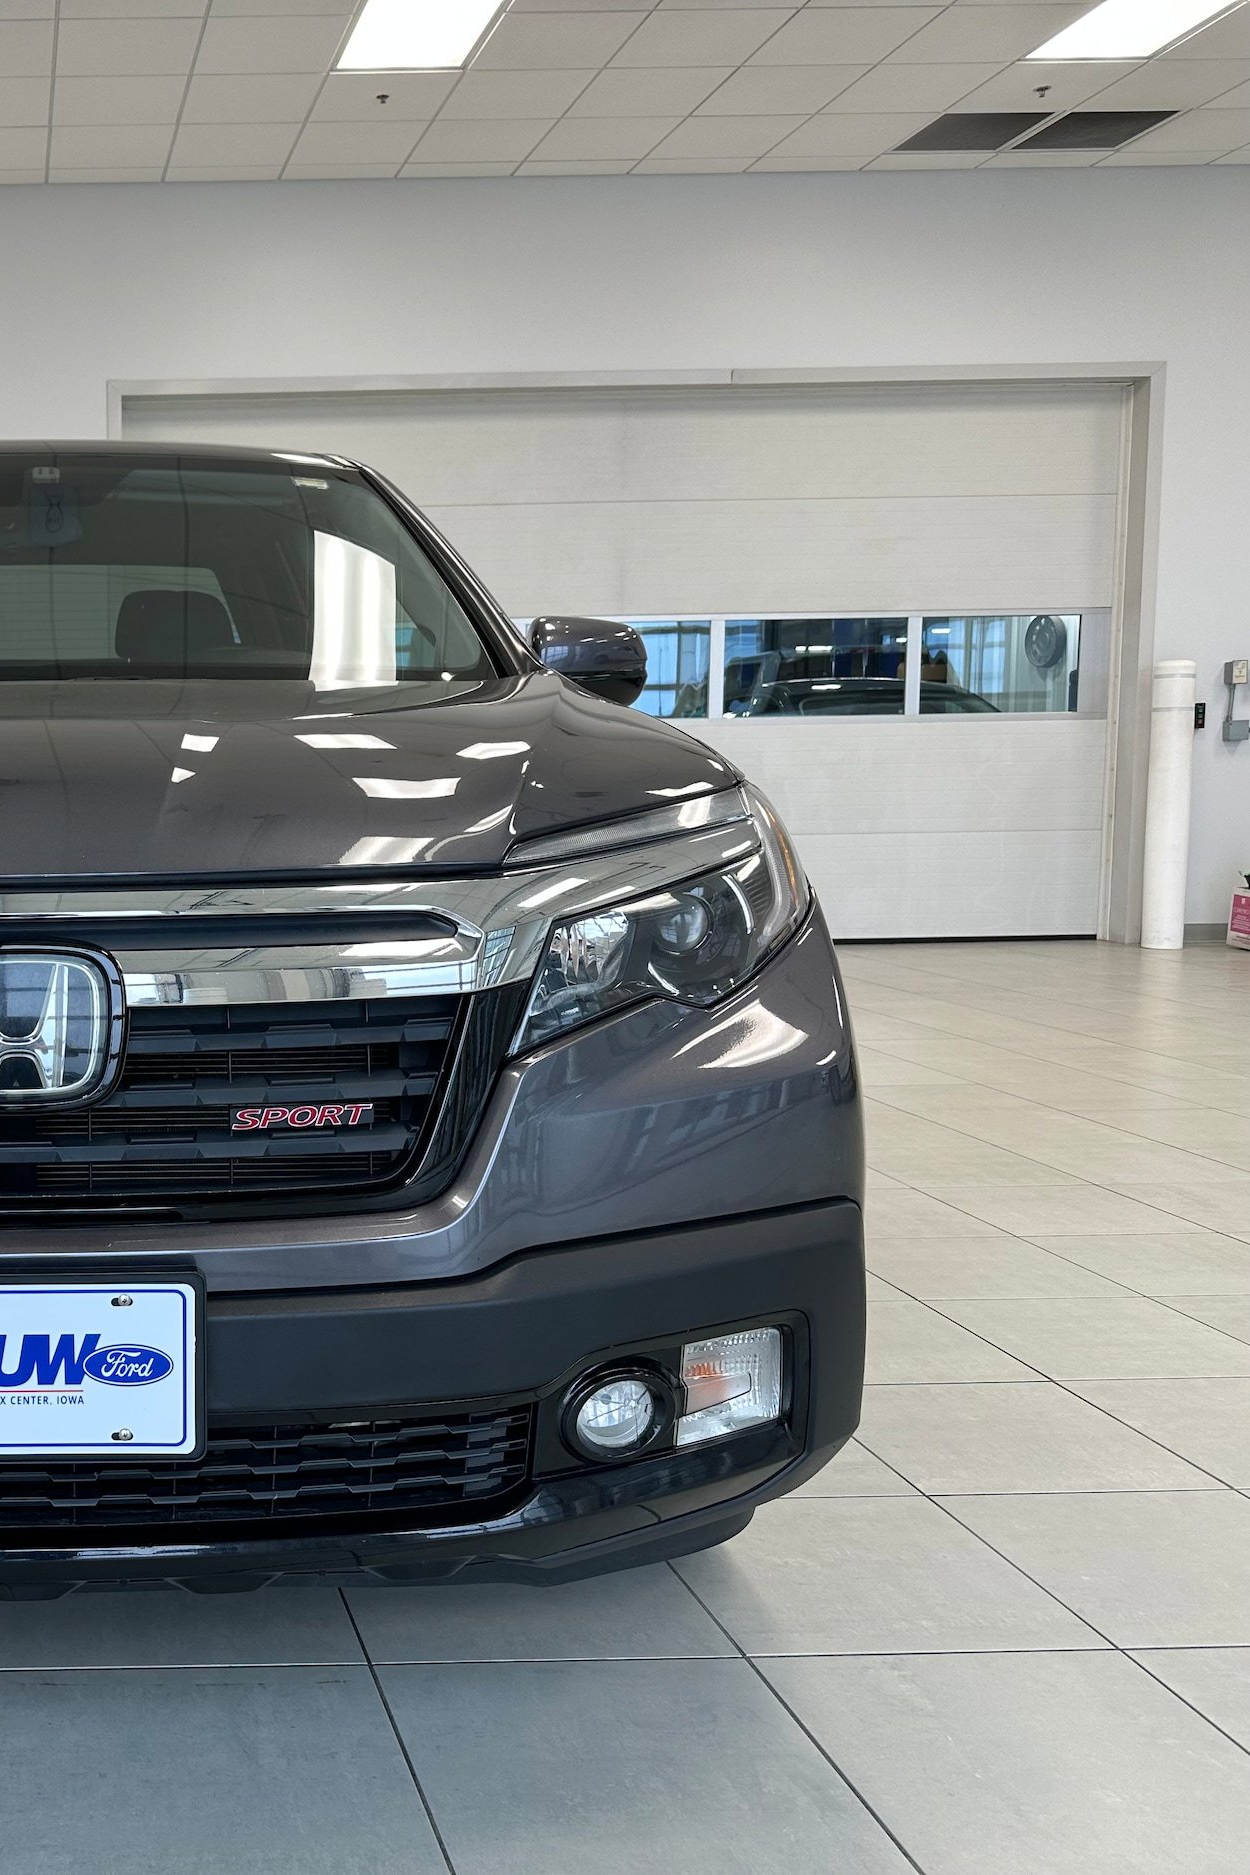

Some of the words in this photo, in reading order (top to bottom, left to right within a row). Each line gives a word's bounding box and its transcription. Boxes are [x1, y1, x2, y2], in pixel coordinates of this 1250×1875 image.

[232, 1103, 373, 1130] SPORT
[100, 1351, 153, 1378] Ford
[56, 1394, 85, 1405] IOWA
